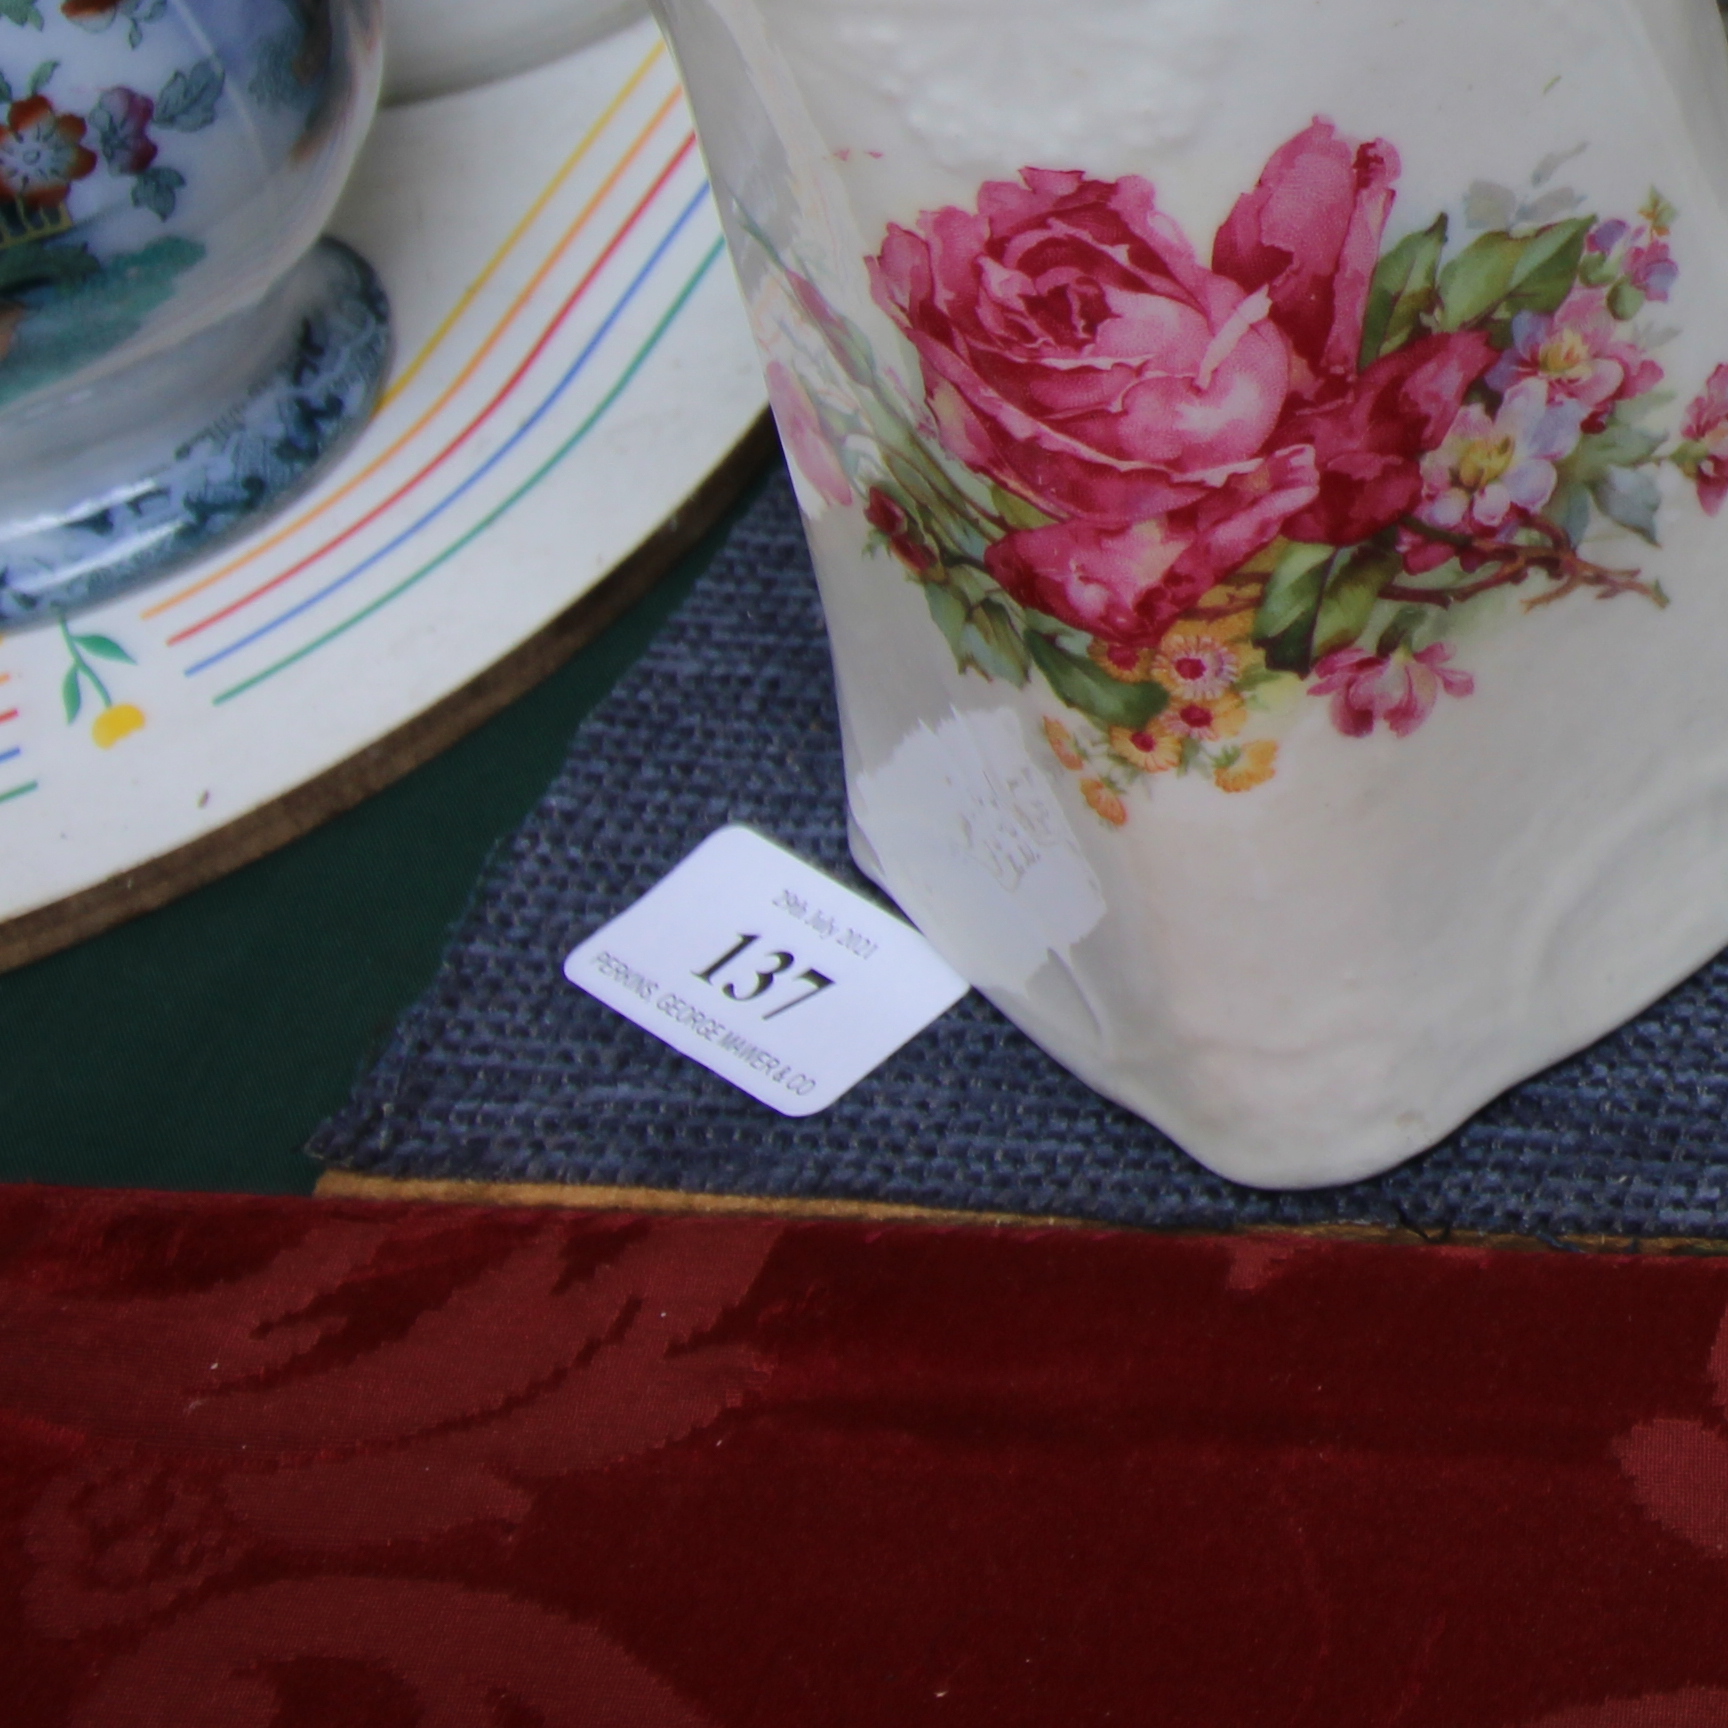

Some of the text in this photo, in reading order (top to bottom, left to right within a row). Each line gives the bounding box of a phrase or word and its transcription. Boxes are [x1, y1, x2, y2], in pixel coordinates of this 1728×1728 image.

[691, 932, 836, 1021] 137
[657, 992, 725, 1042] GEORGE
[718, 1030, 781, 1077] MAWER
[772, 1064, 792, 1083] &
[787, 1072, 817, 1096] CO
